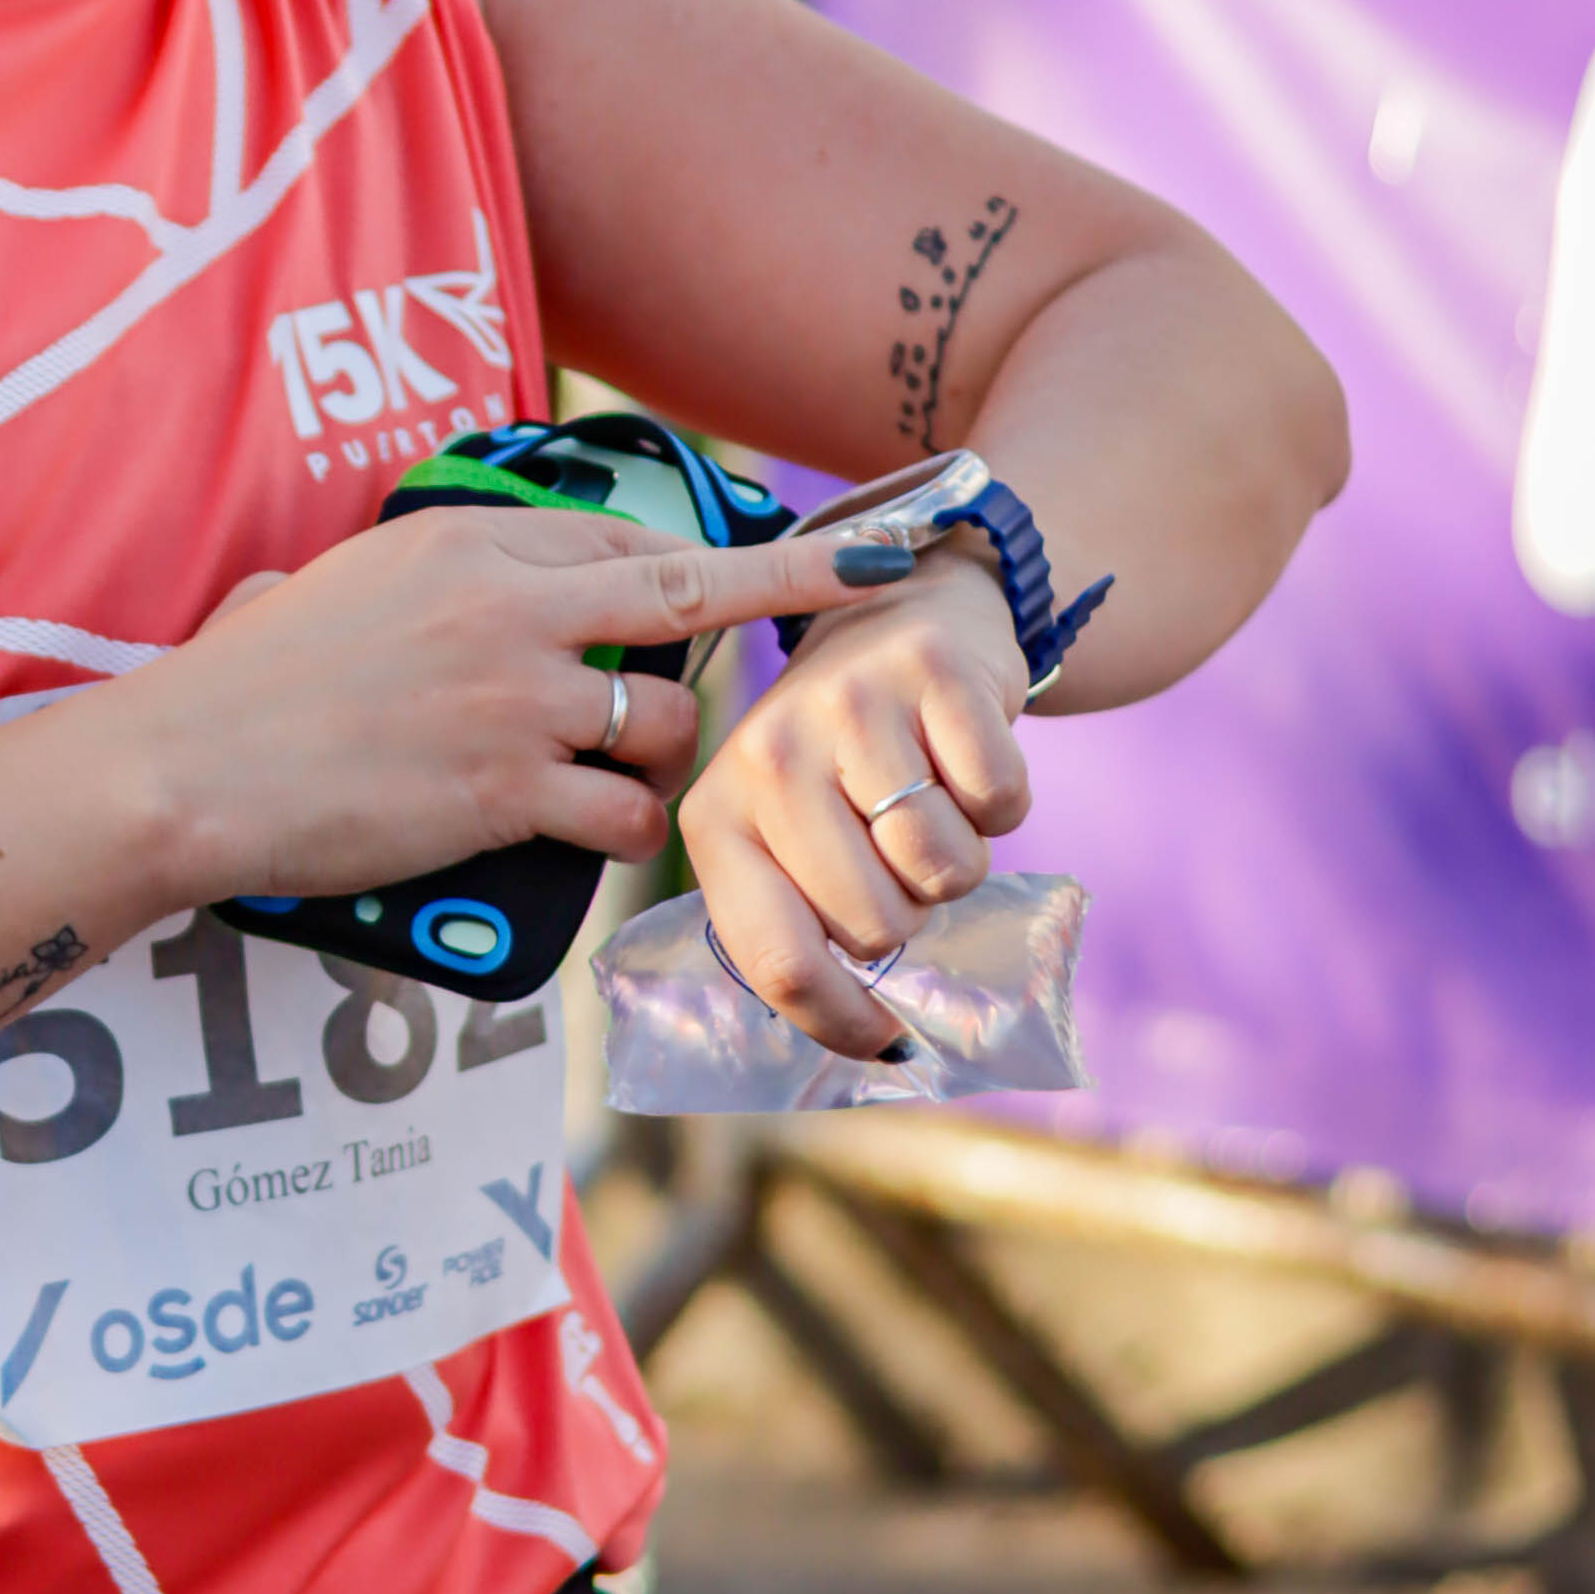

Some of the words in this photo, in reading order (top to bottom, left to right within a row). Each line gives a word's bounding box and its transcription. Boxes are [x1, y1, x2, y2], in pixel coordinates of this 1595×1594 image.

[267, 284, 459, 439] 15K
[187, 1162, 334, 1212] Gómez
[342, 1125, 432, 1184] Tania
[90, 1261, 315, 1381] osde
